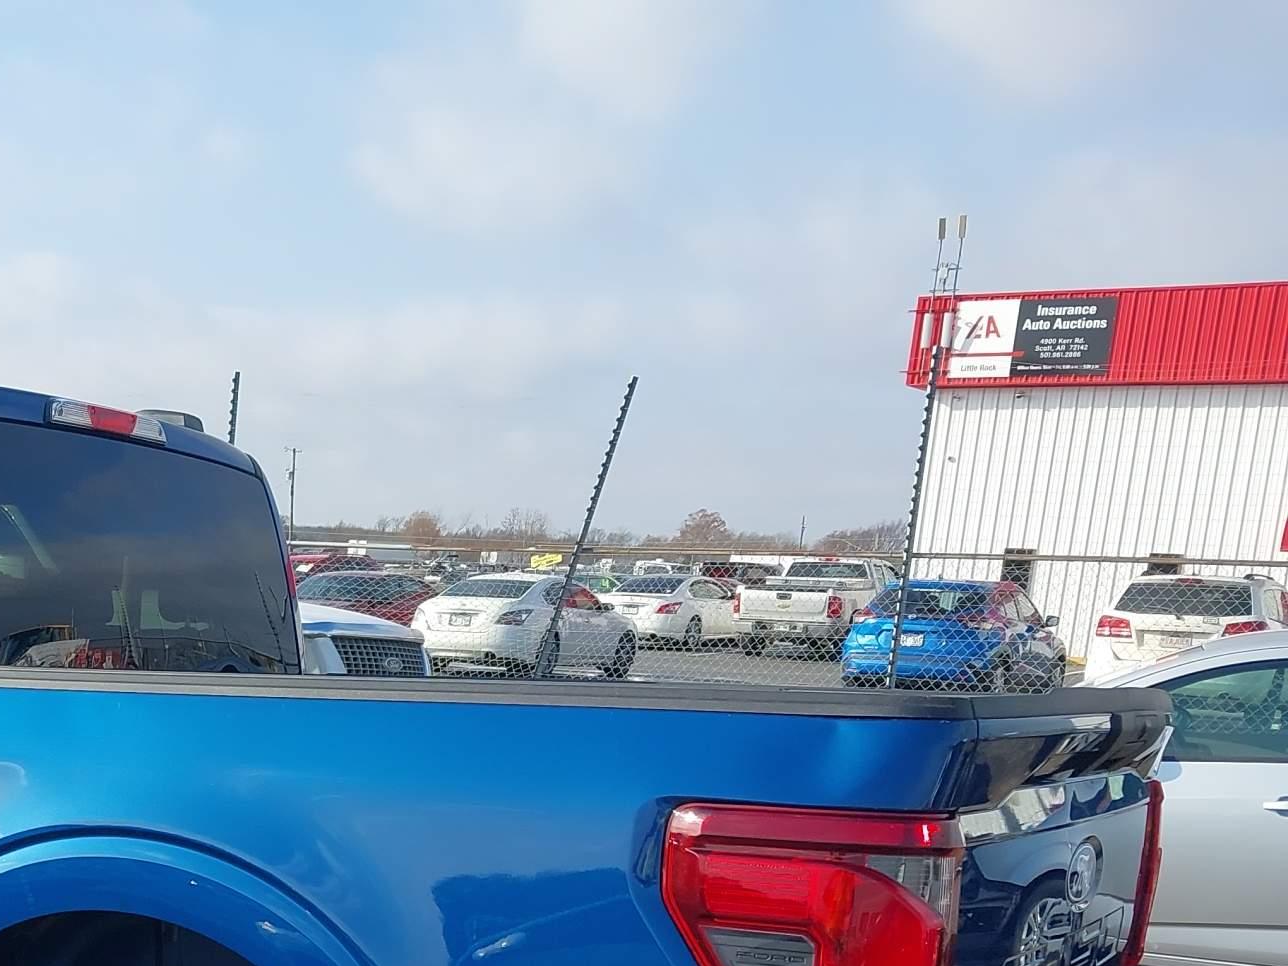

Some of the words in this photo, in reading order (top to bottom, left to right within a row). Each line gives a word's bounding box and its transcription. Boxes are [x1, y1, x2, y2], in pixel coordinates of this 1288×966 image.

[1036, 304, 1098, 316] Insurance
[1022, 318, 1050, 330] Auto
[1053, 317, 1108, 330] Auctions
[961, 364, 978, 372] Little
[735, 950, 806, 963] FORD
